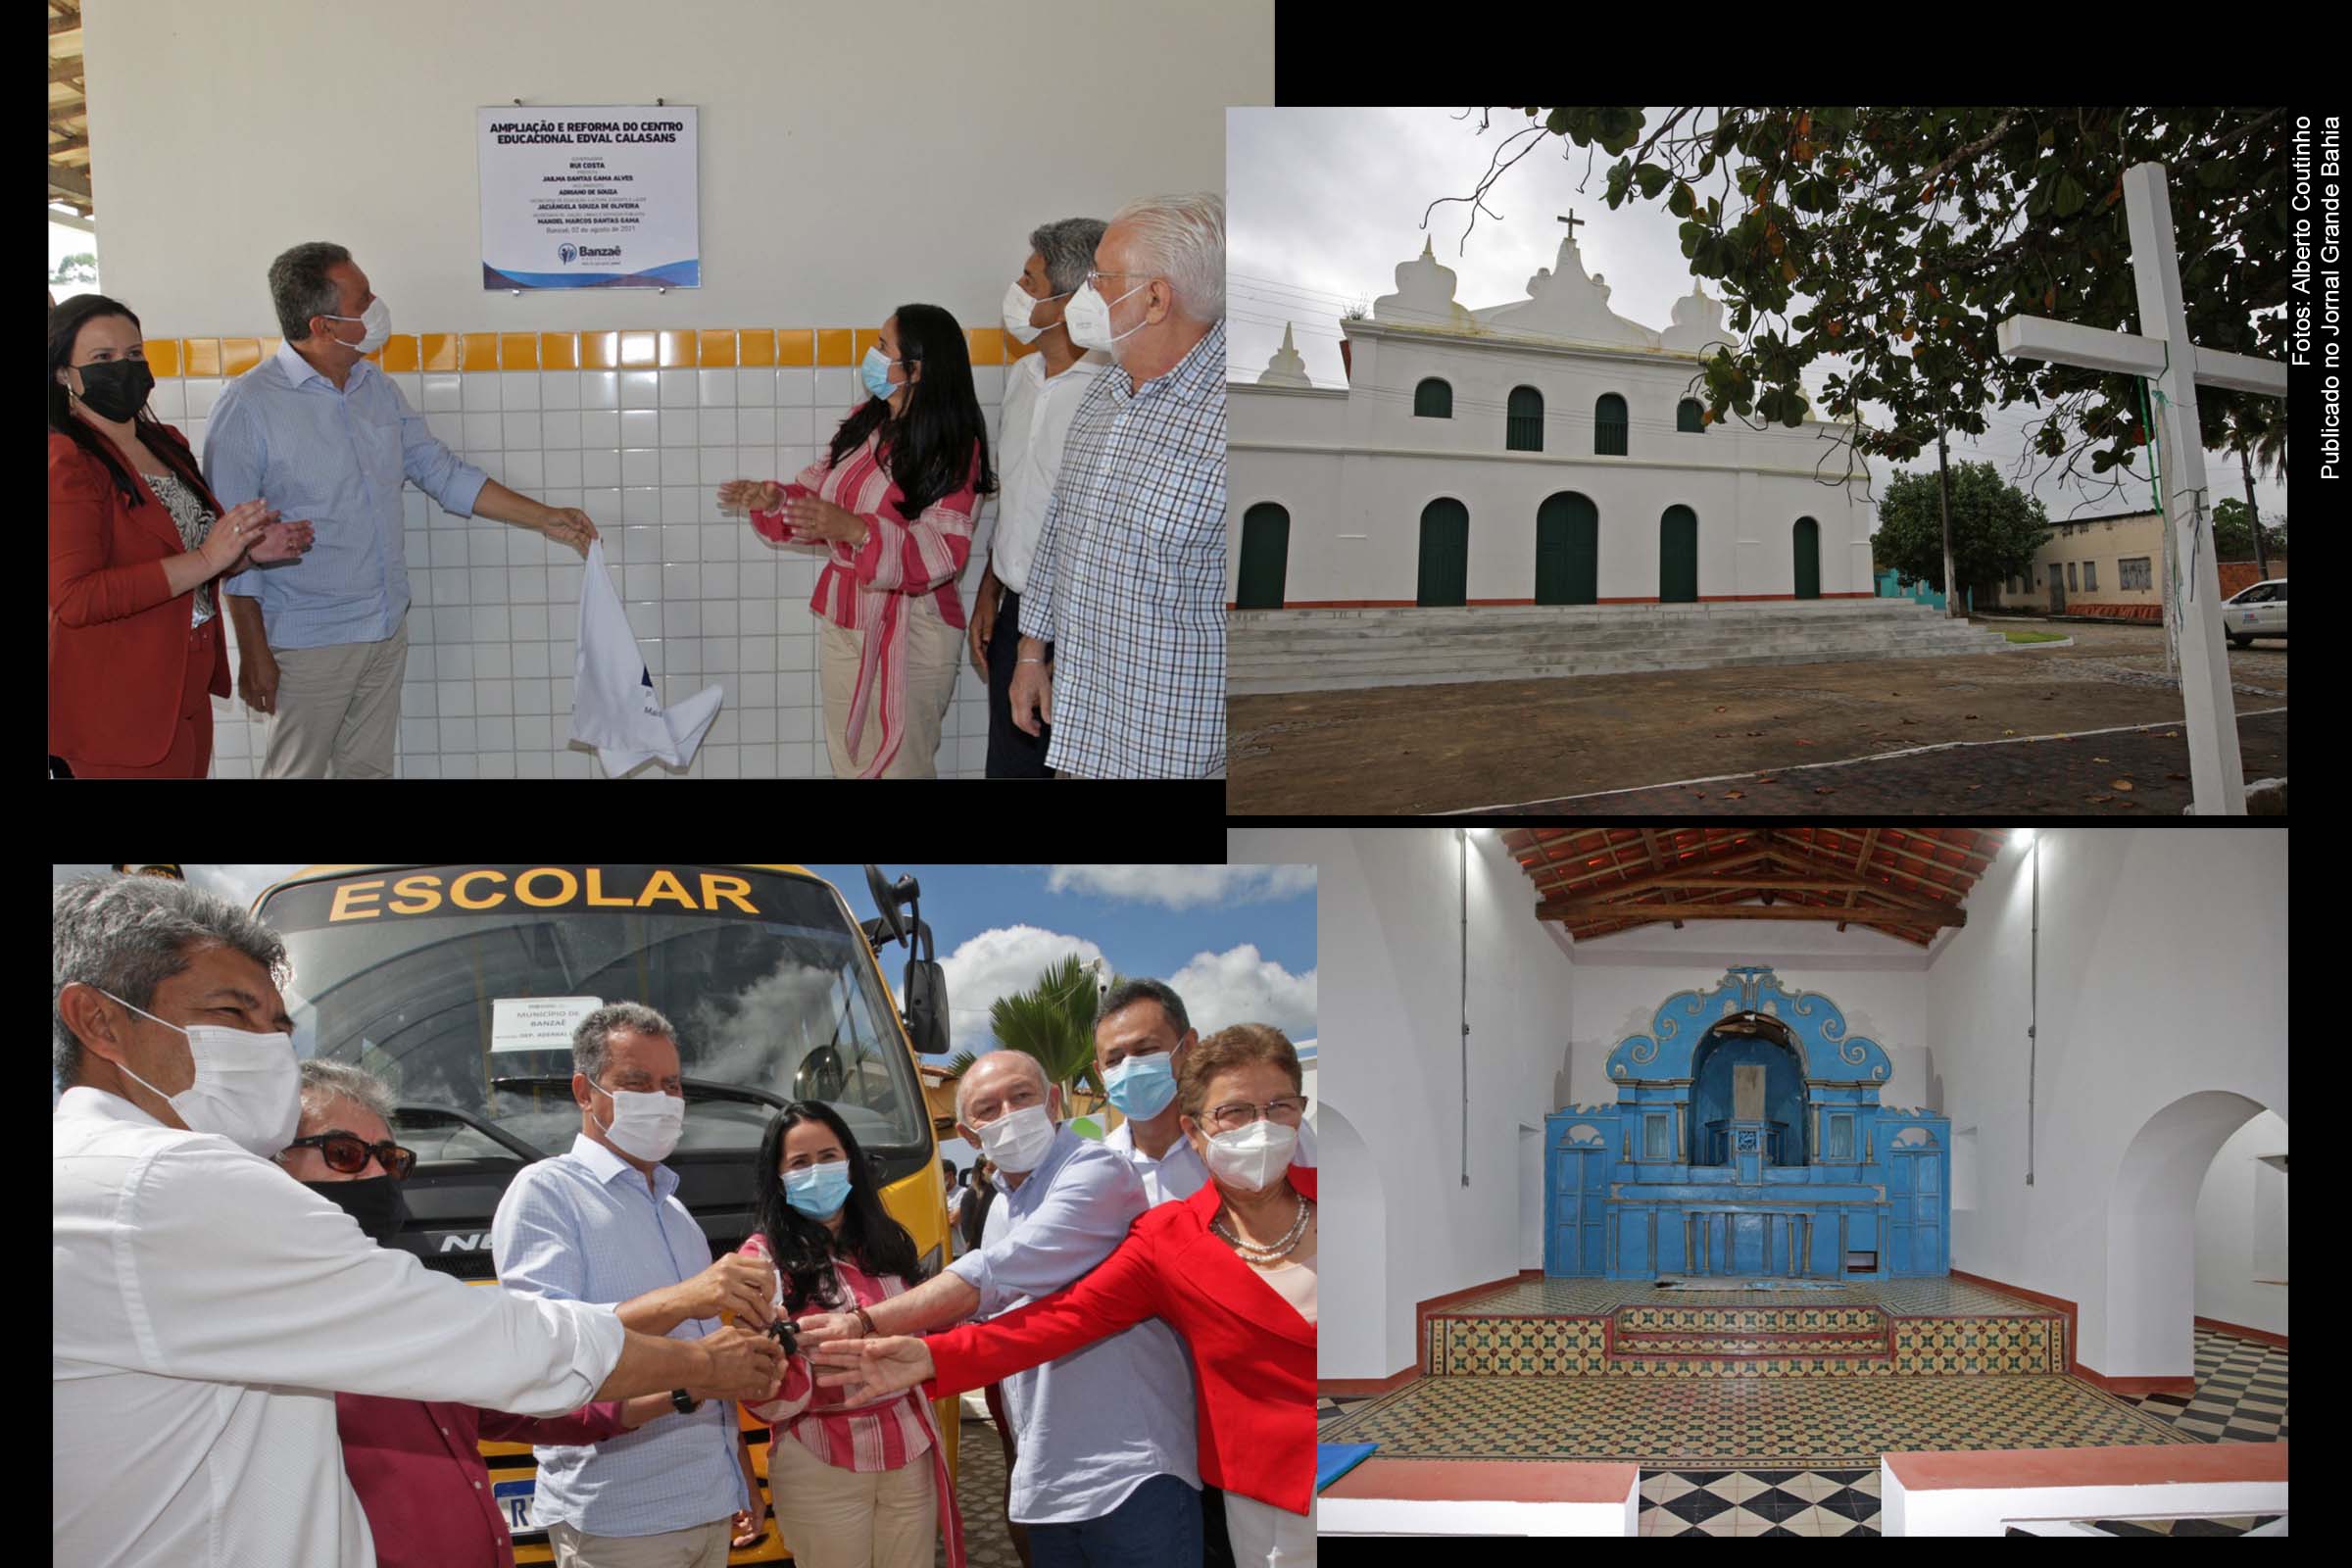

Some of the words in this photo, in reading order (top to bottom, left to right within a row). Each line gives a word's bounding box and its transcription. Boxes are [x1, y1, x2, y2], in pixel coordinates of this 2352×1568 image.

[490, 120, 555, 135] AMPLIAÇÃO
[558, 122, 564, 132] E
[566, 122, 619, 132] REFORMA
[623, 122, 639, 131] DO
[641, 122, 683, 131] CENTRO
[498, 134, 574, 144] EDUCACIONAL
[577, 133, 612, 143] EDVAL
[615, 133, 676, 143] CALASANS
[579, 245, 621, 257] Banzaê
[328, 867, 760, 922] ESCOLAR
